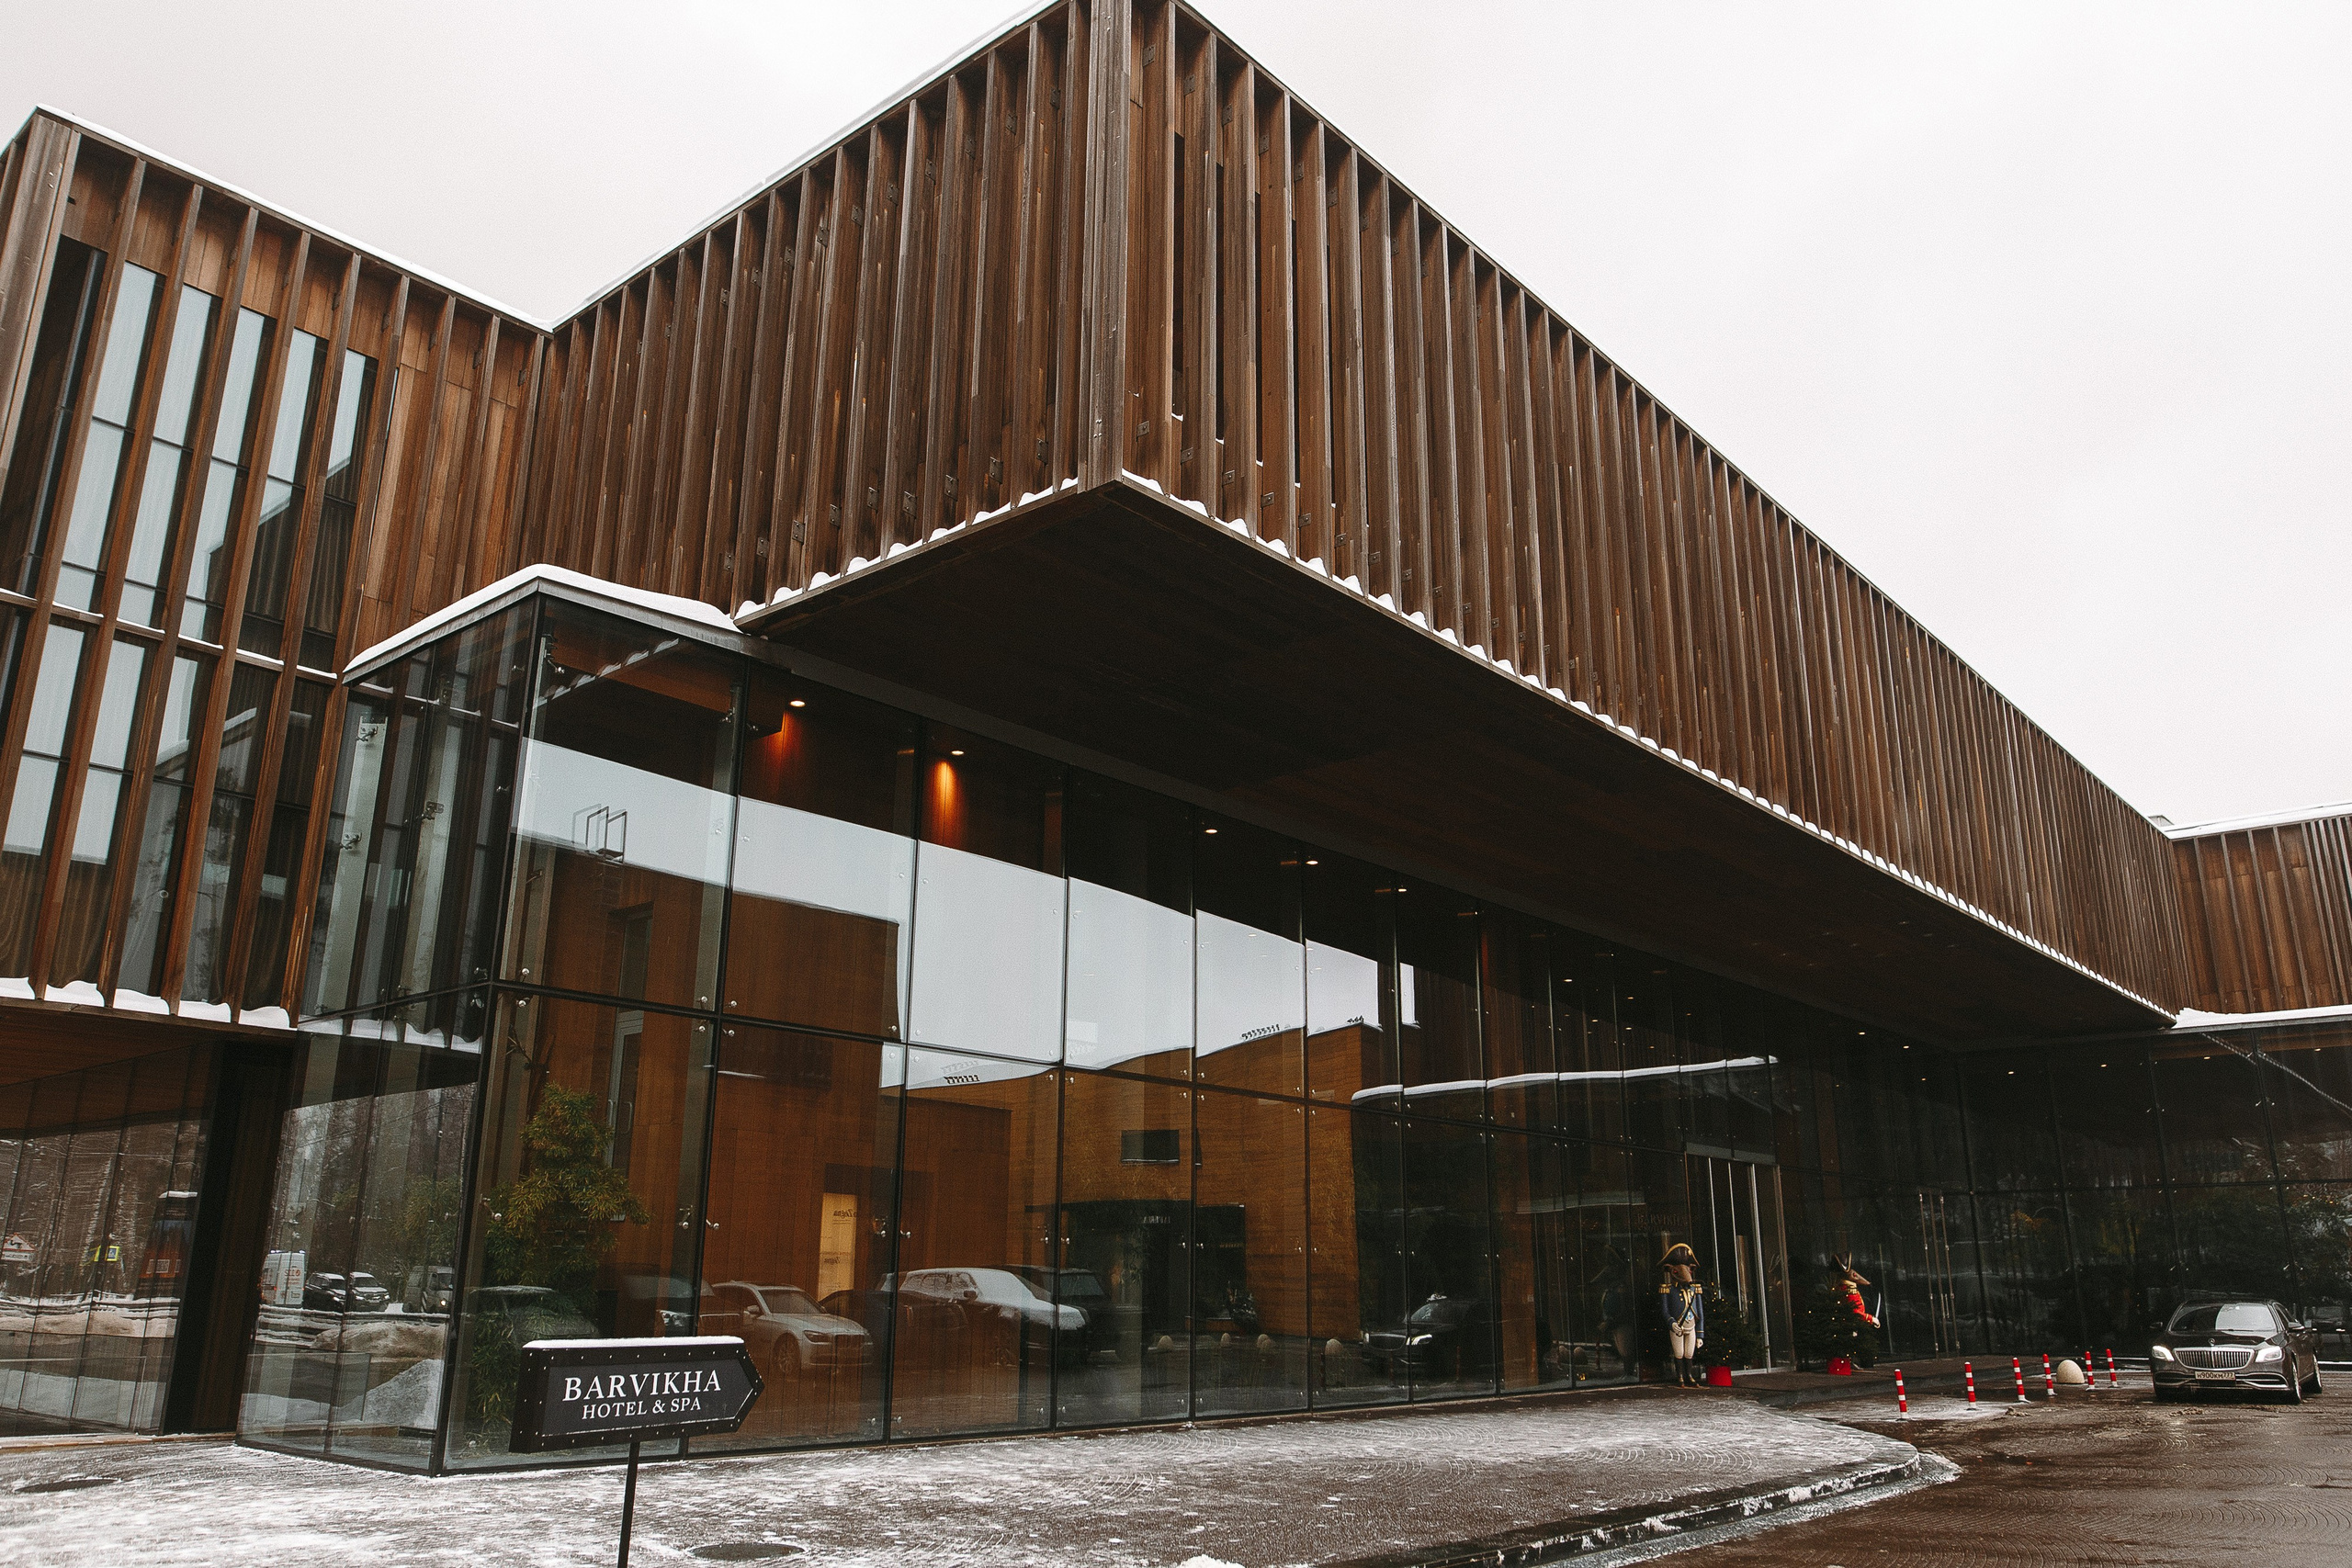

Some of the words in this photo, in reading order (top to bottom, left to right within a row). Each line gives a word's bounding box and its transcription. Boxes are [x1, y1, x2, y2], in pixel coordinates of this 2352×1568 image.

[562, 1370, 721, 1401] BARVIKHA
[582, 1401, 648, 1419] HOTEL
[652, 1399, 666, 1414] &
[671, 1396, 701, 1412] SPA
